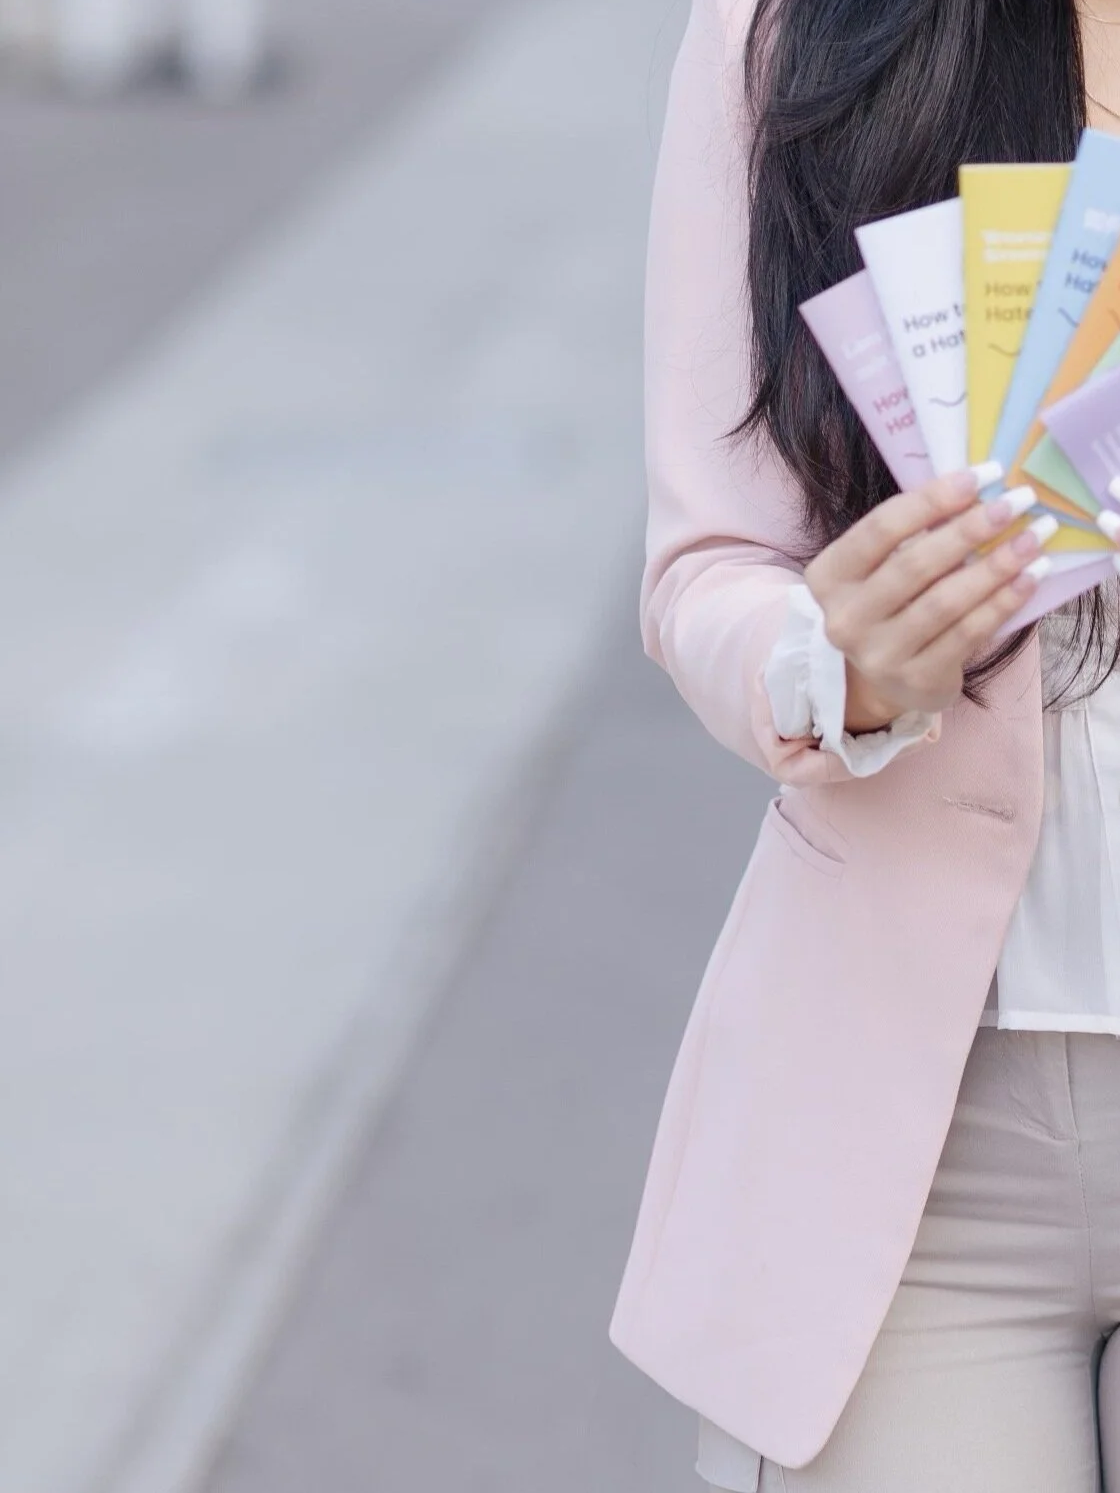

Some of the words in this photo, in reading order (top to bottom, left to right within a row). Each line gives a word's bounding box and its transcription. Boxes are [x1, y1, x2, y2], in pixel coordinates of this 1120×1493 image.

[984, 281, 1031, 297] How
[902, 309, 949, 333] How
[912, 342, 927, 359] a
